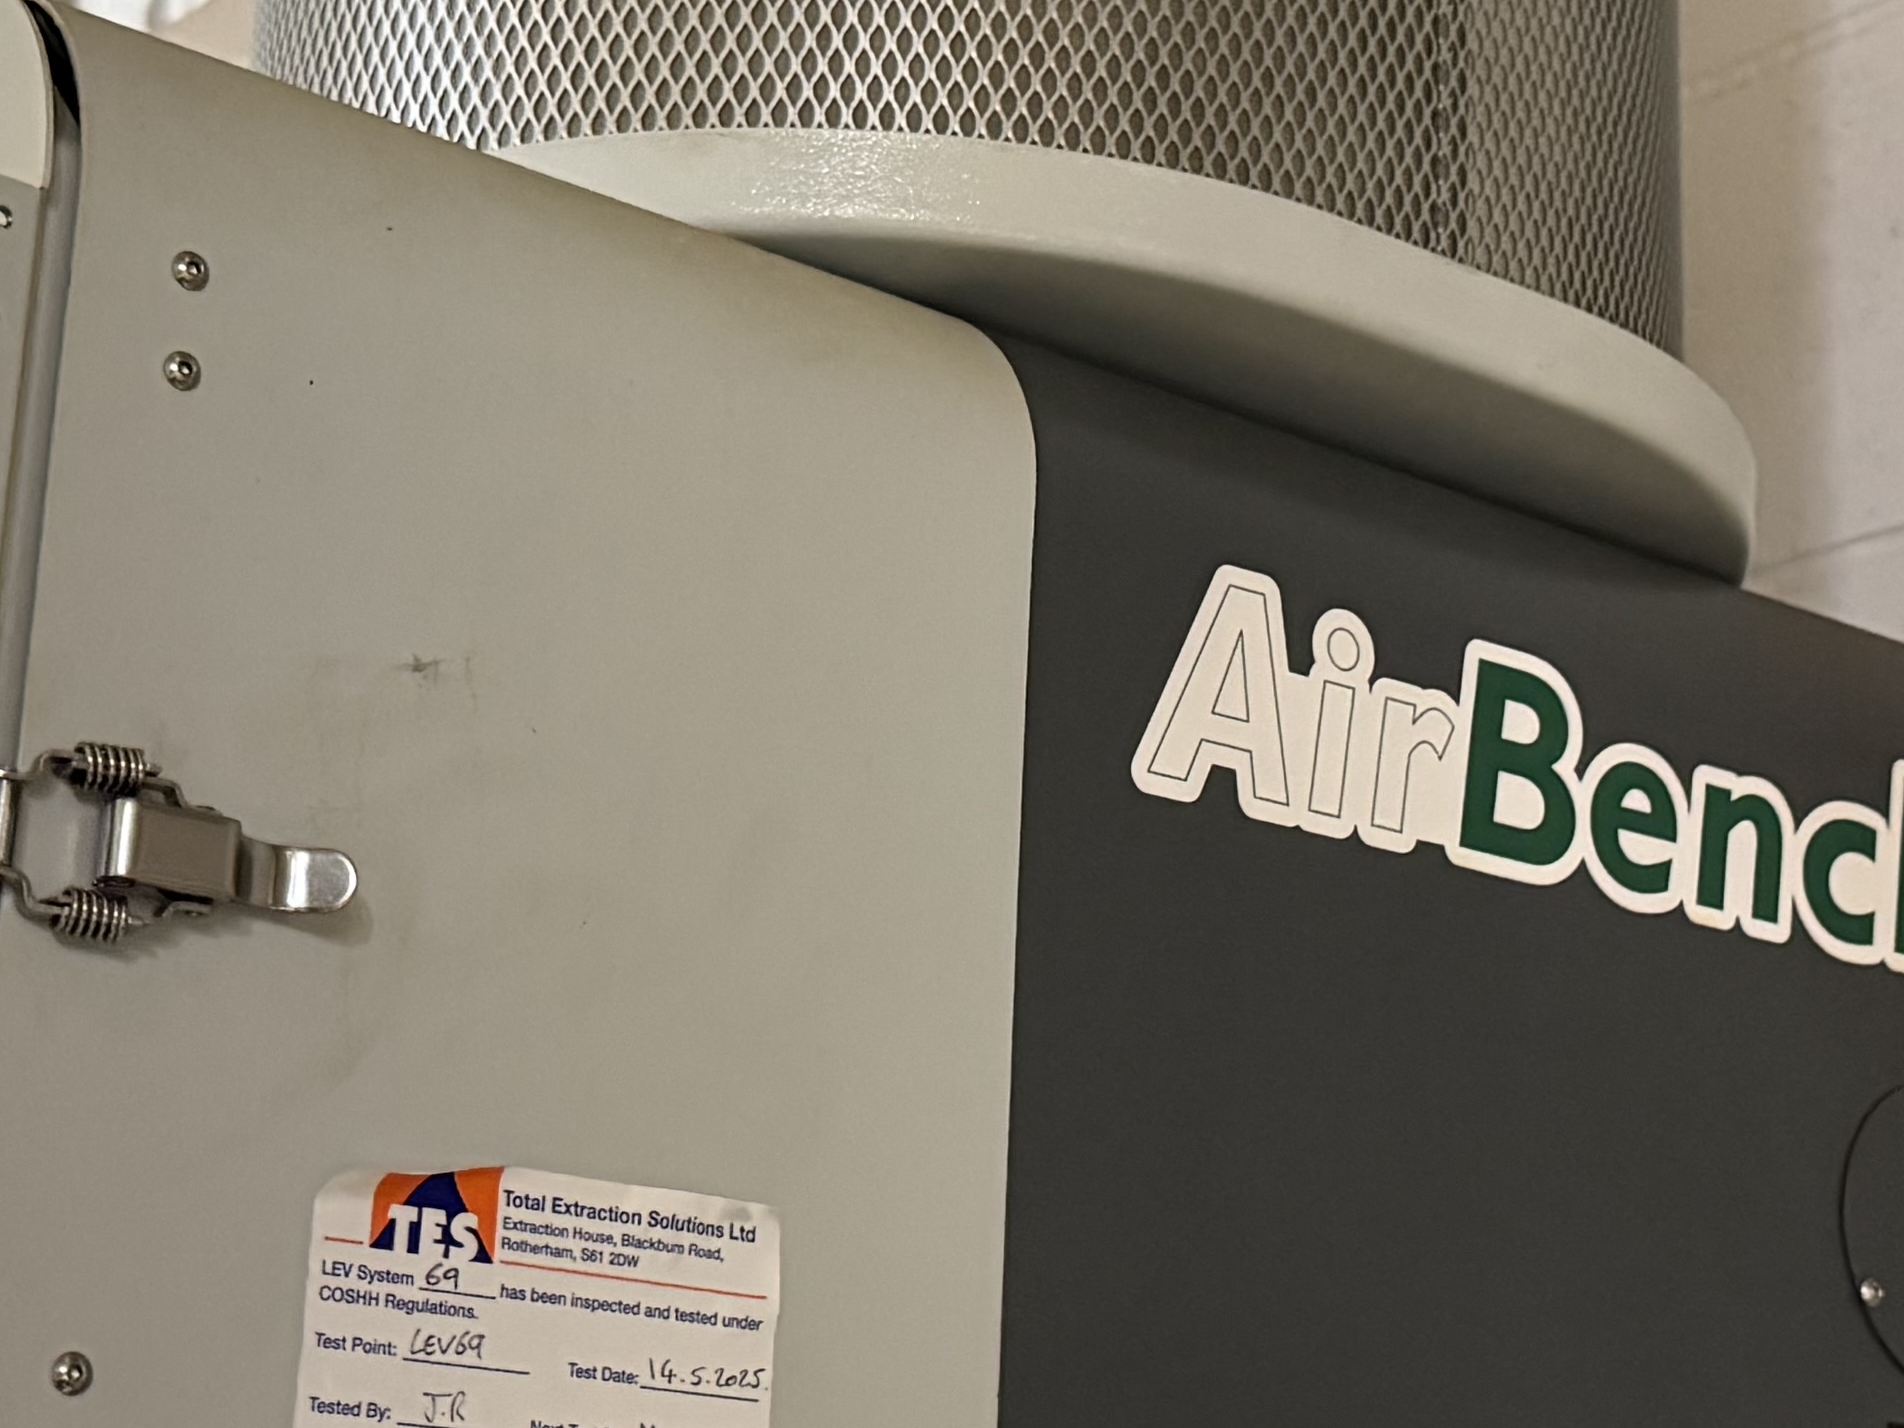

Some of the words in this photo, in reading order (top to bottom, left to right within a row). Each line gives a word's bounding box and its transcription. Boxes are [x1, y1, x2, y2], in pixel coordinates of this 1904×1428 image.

[503, 1190, 546, 1215] Total
[552, 1197, 642, 1227] Extraction
[647, 1210, 725, 1241] Solutions
[729, 1222, 756, 1243] Ltd
[388, 1204, 480, 1264] TES
[502, 1218, 569, 1241] Extraction
[572, 1228, 618, 1249] House,
[621, 1231, 685, 1257] Blackburn
[688, 1243, 725, 1262] Road,
[501, 1237, 577, 1262] Rotherham,
[581, 1247, 604, 1264] S61
[609, 1251, 640, 1269] 2DW
[322, 1261, 353, 1278] LEV
[357, 1264, 415, 1288] System
[425, 1264, 460, 1291] 69
[319, 1286, 380, 1308] COSHH
[384, 1291, 478, 1320] Regulations.
[500, 1285, 526, 1301] has
[530, 1287, 567, 1306] been
[571, 1290, 641, 1318] inspected
[644, 1301, 671, 1319] and
[674, 1303, 719, 1326] tested
[723, 1311, 763, 1332] under
[315, 1331, 348, 1351] Test
[352, 1338, 397, 1356] Point:
[568, 1362, 598, 1382] Test
[601, 1365, 639, 1385] Date:
[310, 1397, 364, 1417] Tested
[366, 1404, 392, 1422] By:
